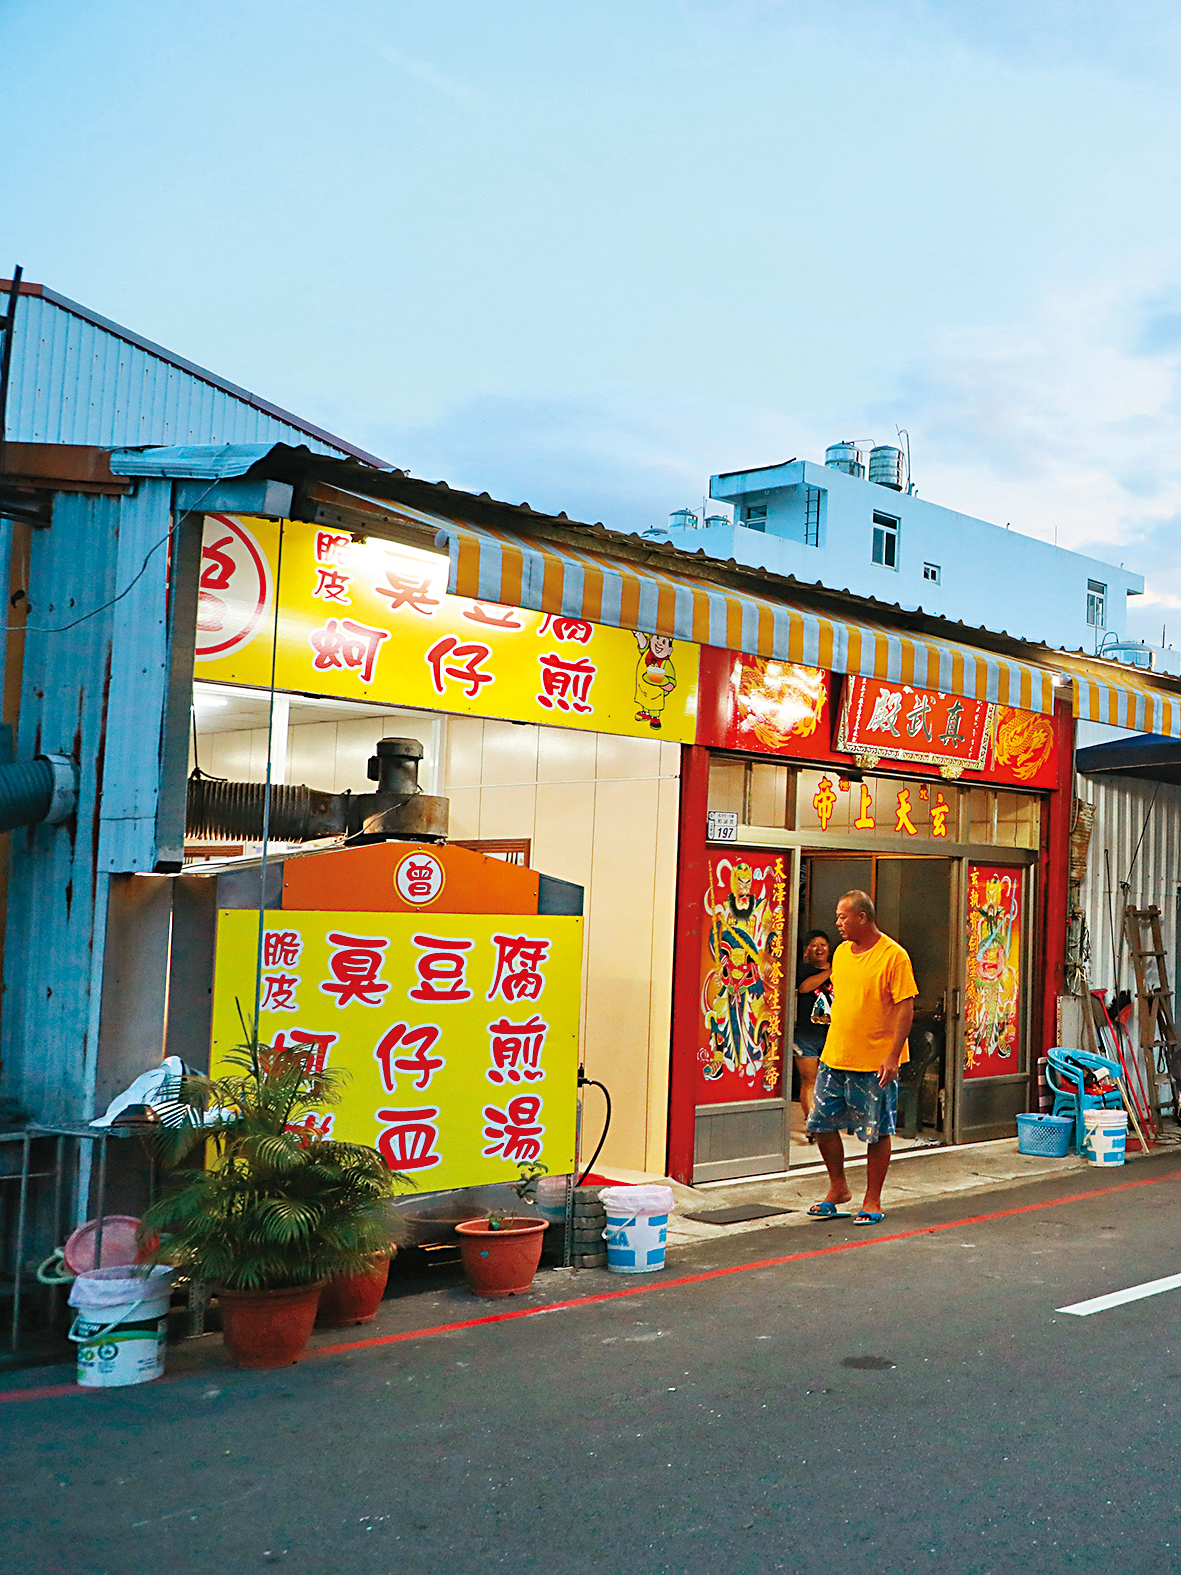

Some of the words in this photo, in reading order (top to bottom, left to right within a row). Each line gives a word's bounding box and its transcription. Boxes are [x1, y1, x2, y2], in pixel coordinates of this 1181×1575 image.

[313, 532, 351, 602] 脆皮
[312, 620, 594, 714] 蚵仔煎
[718, 827, 734, 839] 197
[813, 777, 950, 837] 玄天上帝
[406, 860, 434, 897] 曾
[263, 931, 299, 1012] 脆皮
[321, 932, 549, 1006] 臭豆腐
[283, 1096, 541, 1170] 血湯
